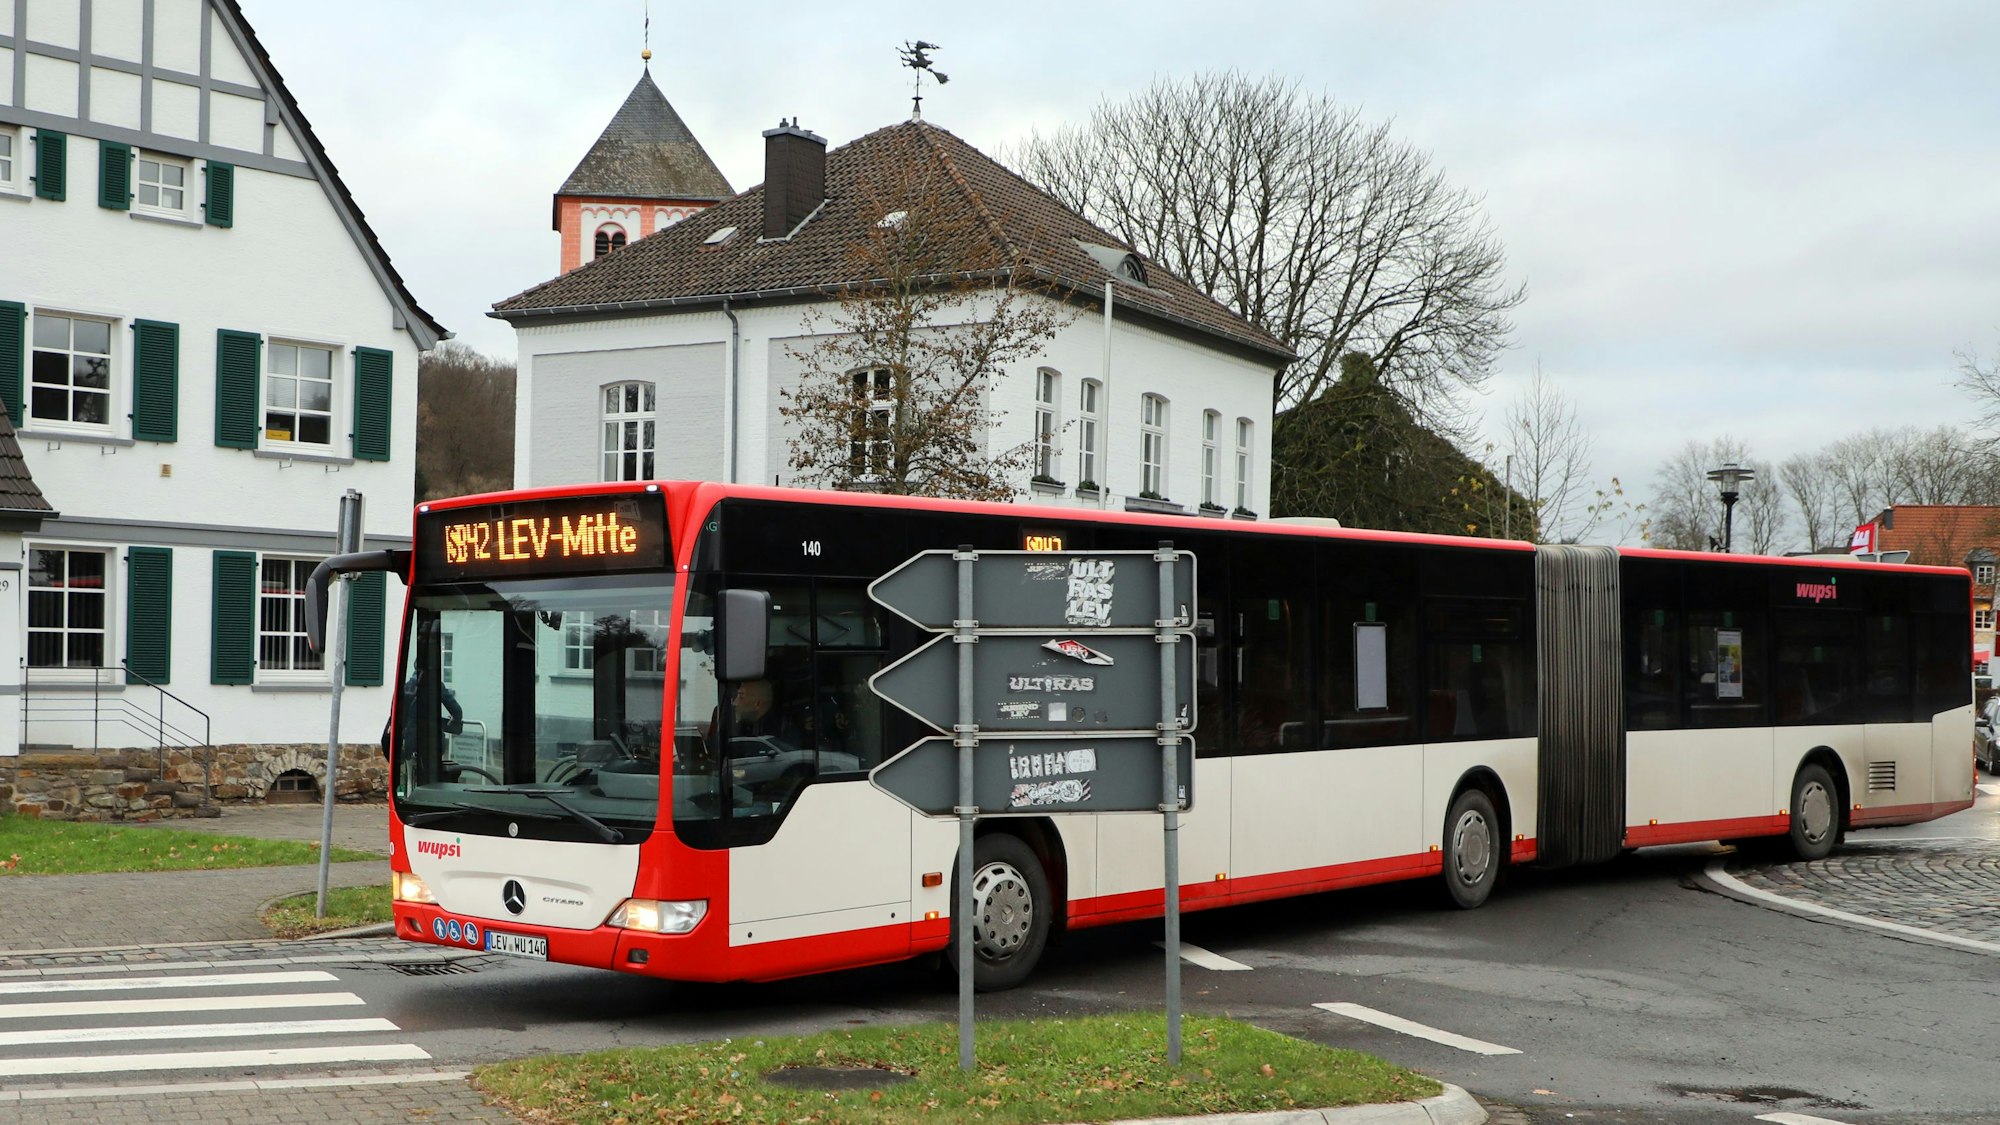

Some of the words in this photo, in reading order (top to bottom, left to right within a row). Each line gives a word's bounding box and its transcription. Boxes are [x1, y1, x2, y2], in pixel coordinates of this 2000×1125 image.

[497, 512, 637, 561] LEV-Mitte
[801, 540, 821, 556] 140
[1796, 576, 1837, 603] wupsi
[1069, 600, 1111, 619] LEV
[1008, 676, 1094, 692] ULTRAS
[418, 836, 461, 860] wupsi
[490, 934, 508, 951] LEV
[514, 937, 526, 953] WU
[528, 939, 546, 956] 140
